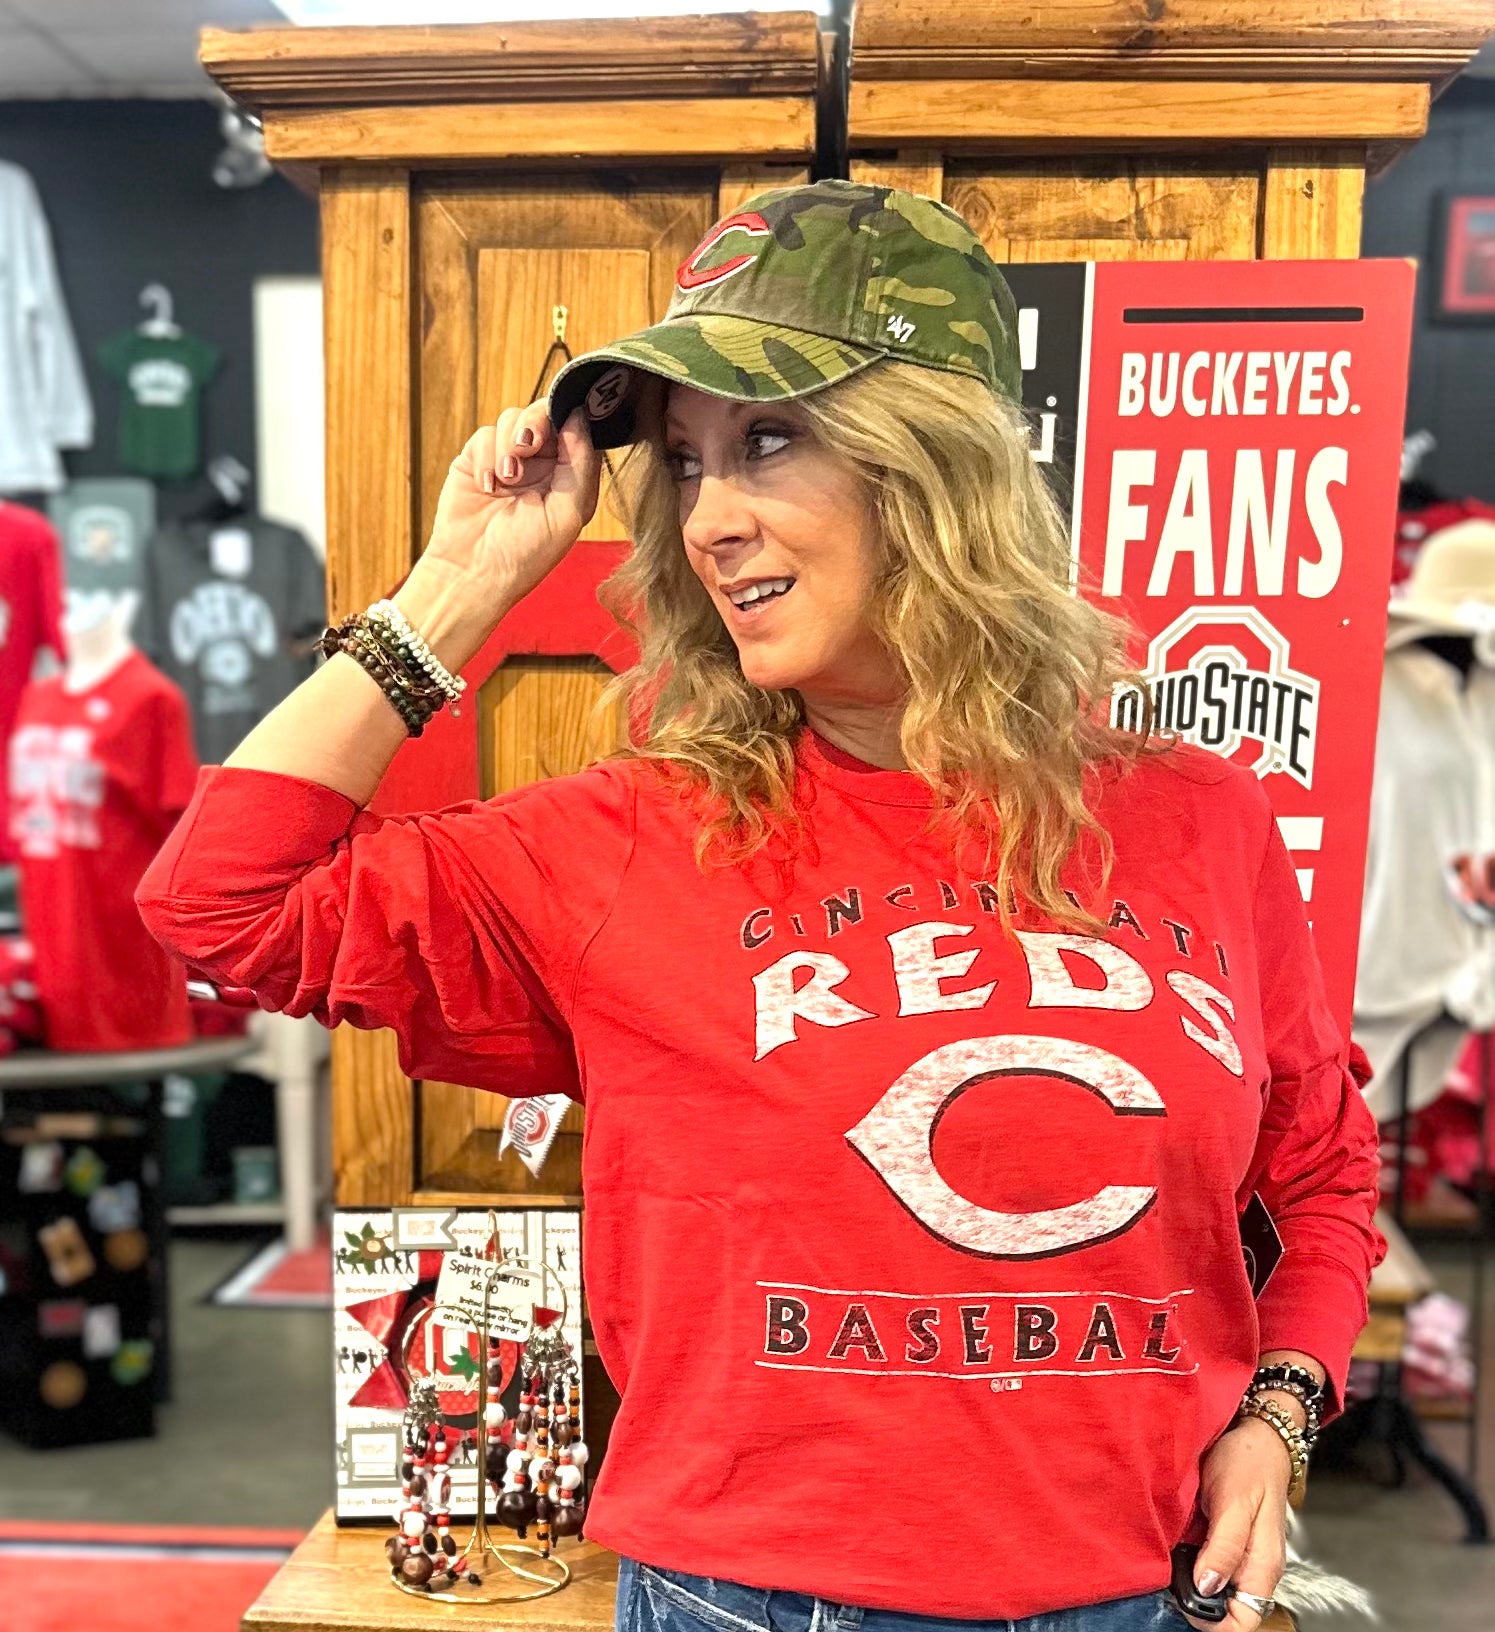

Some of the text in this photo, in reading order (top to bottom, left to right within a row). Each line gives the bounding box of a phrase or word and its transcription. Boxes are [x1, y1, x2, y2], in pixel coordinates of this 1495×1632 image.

[1117, 350, 1361, 418] BUCKEYES.
[1101, 446, 1349, 598] FANS
[740, 877, 1230, 978] CINCINATI
[751, 920, 1244, 1077] REDS
[449, 1259, 482, 1277] Spirit
[474, 1310, 497, 1321] puse
[763, 1293, 1186, 1366] BASEBAL
